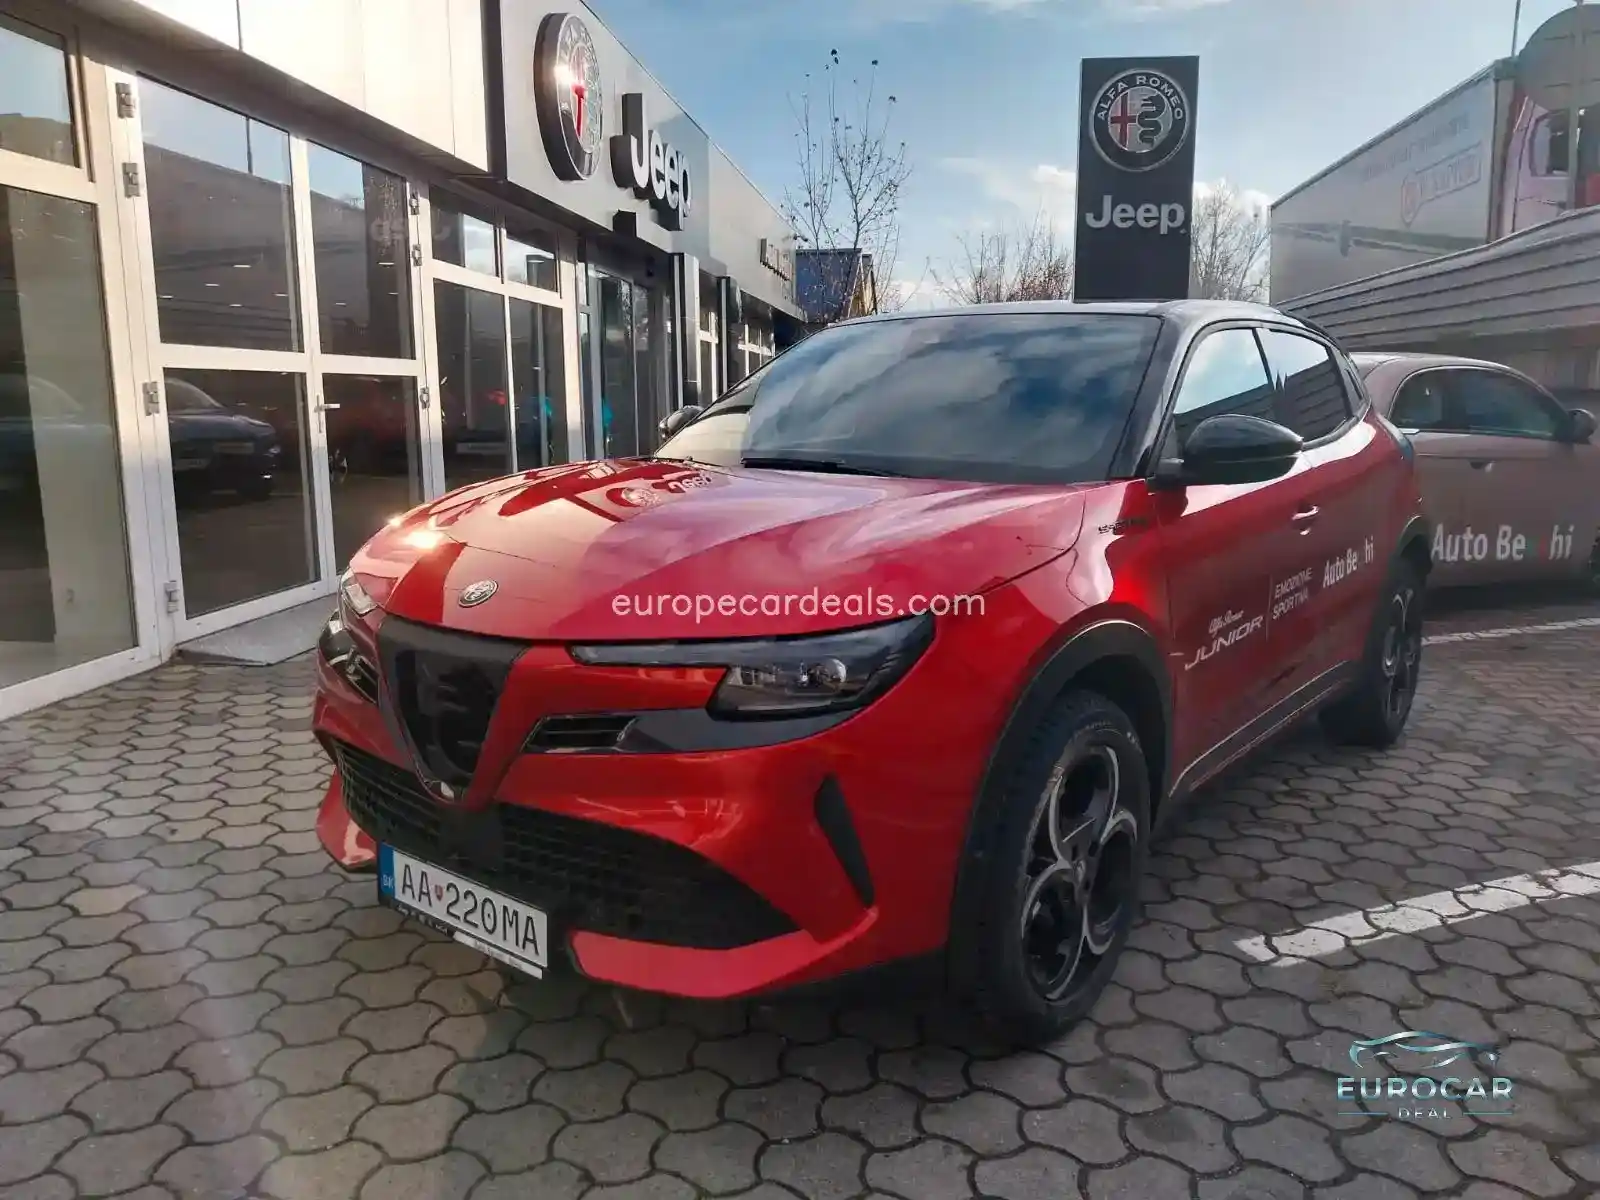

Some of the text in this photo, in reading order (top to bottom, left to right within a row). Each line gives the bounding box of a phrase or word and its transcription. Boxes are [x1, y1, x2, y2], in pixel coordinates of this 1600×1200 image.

[1097, 75, 1184, 120] ALFA ROMEO
[612, 92, 693, 224] Jeep
[1085, 194, 1186, 235] Jeep
[1430, 522, 1488, 562] Auto
[1322, 560, 1345, 589] Auto
[1184, 615, 1264, 671] JUNIOR
[401, 863, 433, 908] AA
[445, 882, 541, 957] 220MA
